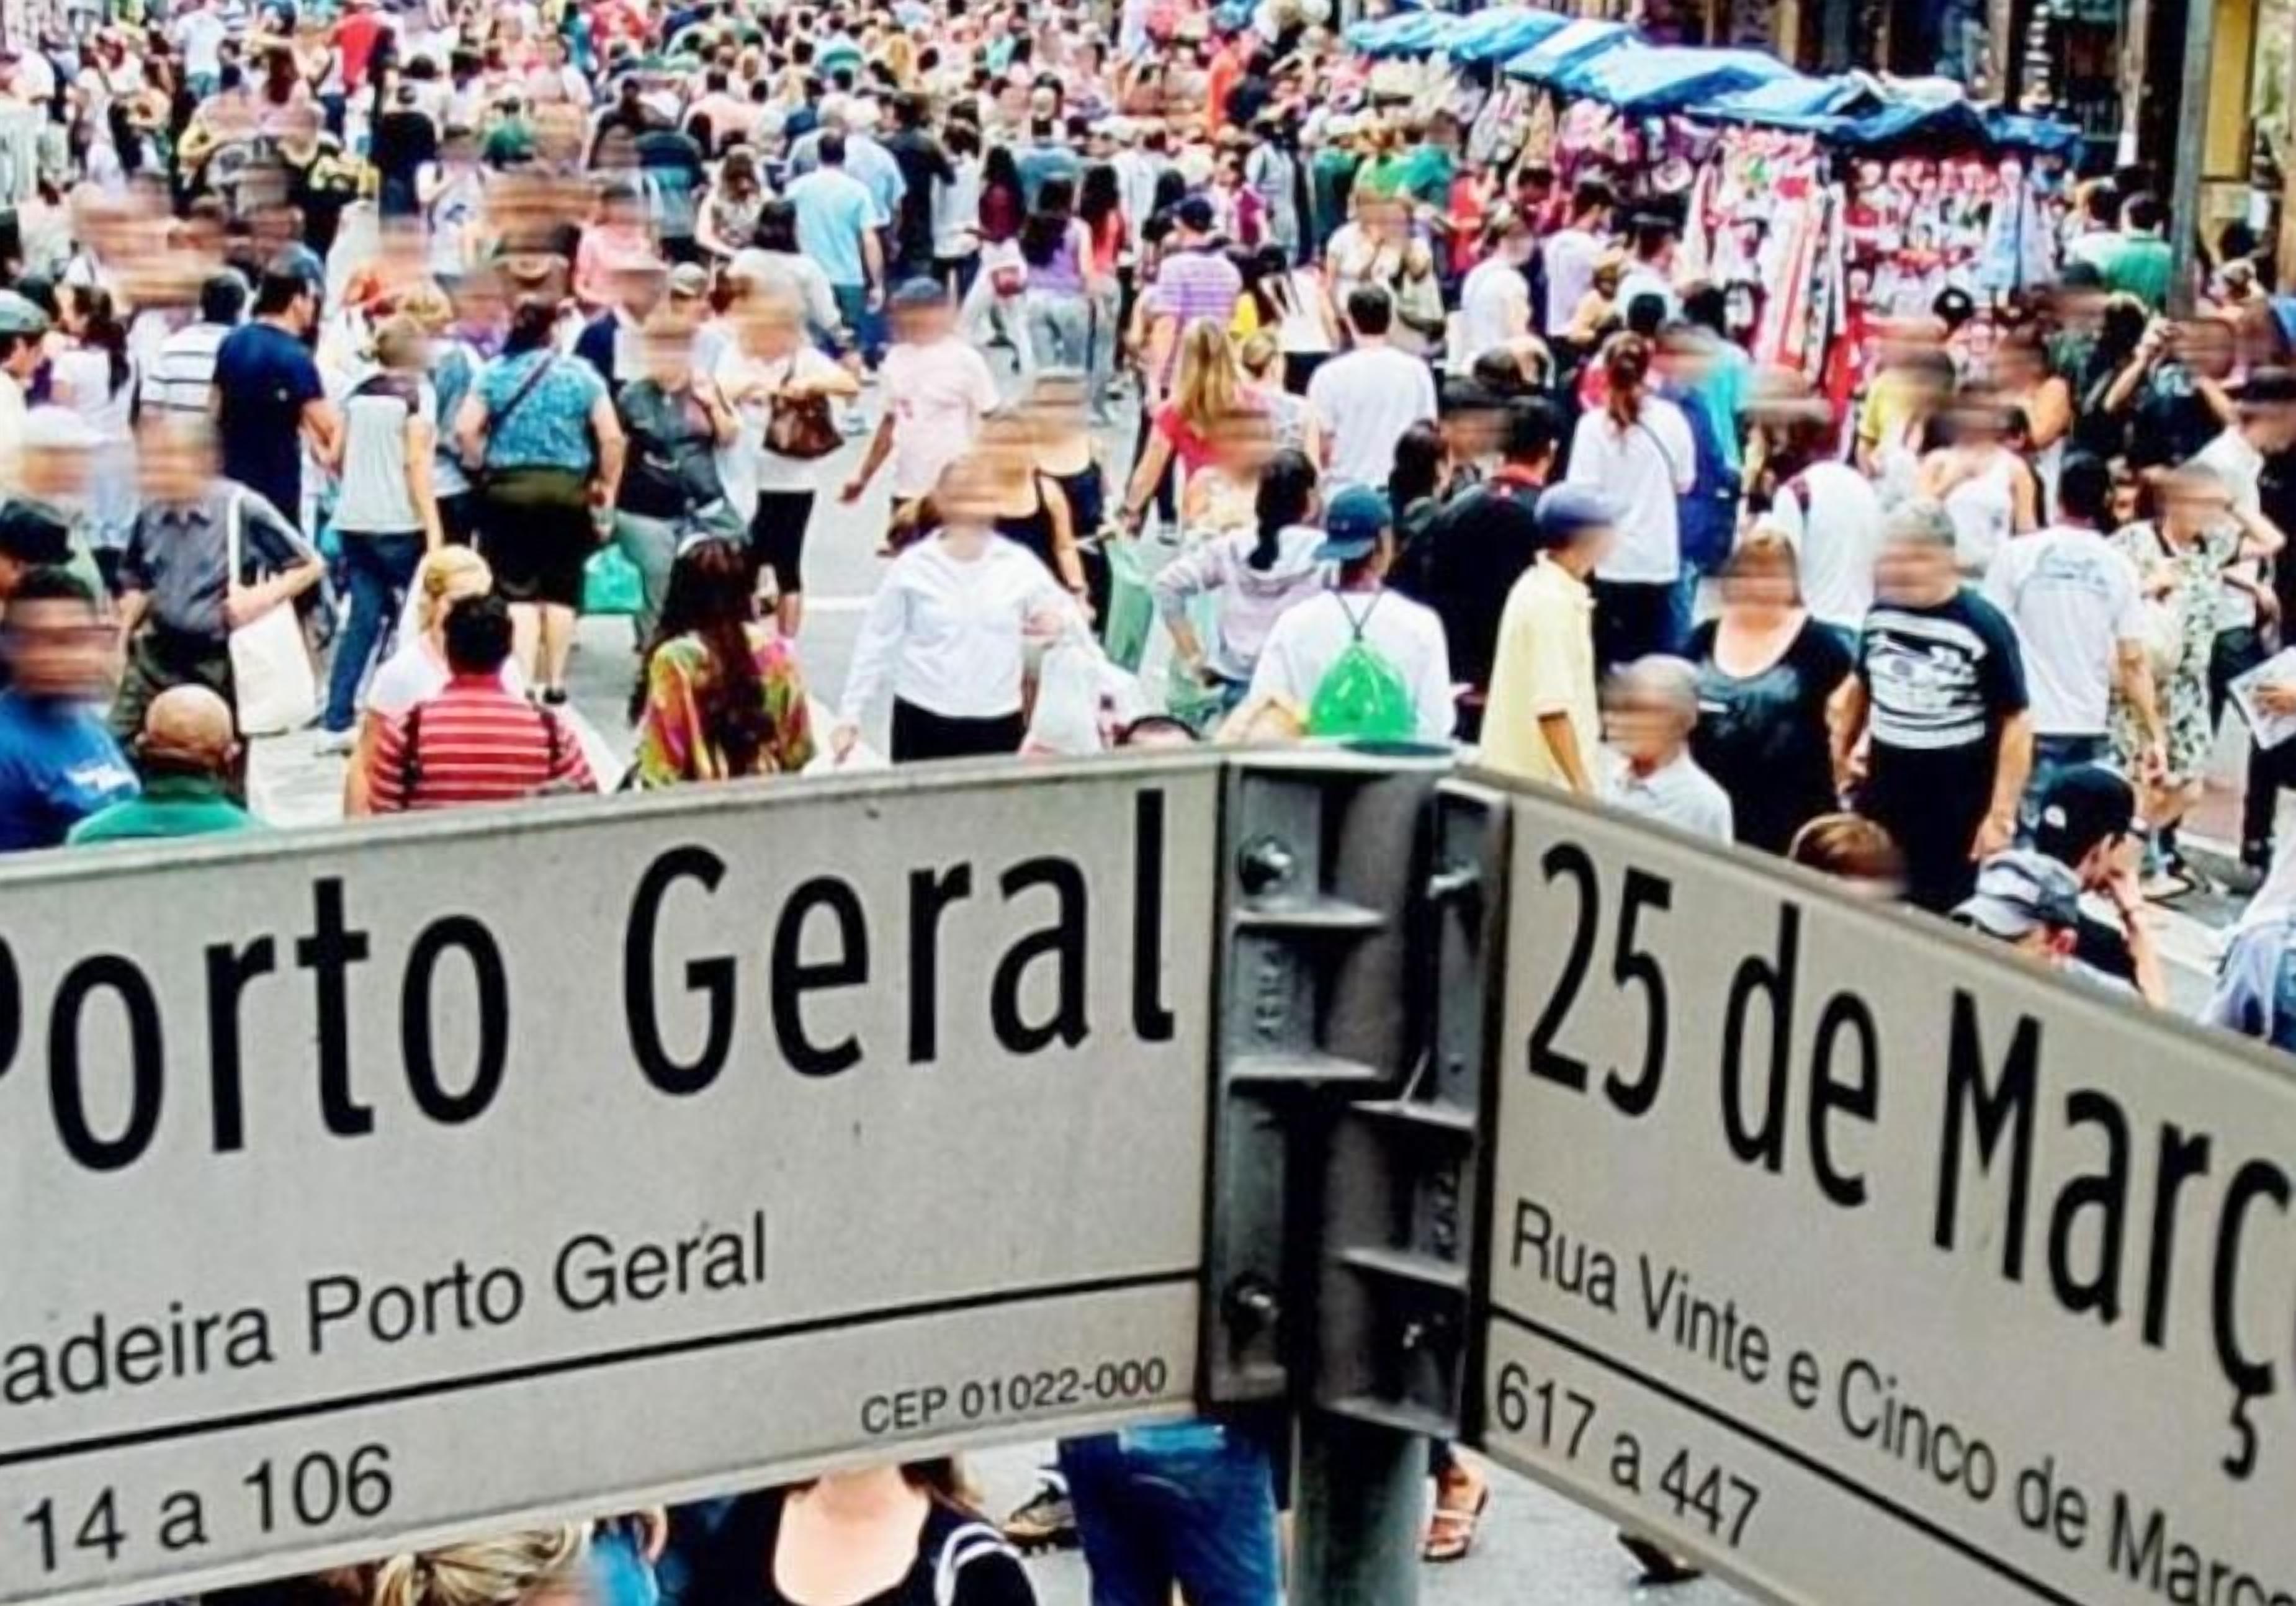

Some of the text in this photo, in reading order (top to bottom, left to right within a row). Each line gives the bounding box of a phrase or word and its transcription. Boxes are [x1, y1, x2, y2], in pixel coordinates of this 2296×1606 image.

[0, 788, 1175, 1173] orto Geral
[1526, 840, 2296, 1482] 25 de Març
[2, 1209, 765, 1406] adeira Porto Geral
[861, 1357, 1168, 1435] CEP 01022-000
[1510, 1196, 1617, 1313] Rua
[1638, 1254, 1770, 1384] Vinte
[1787, 1350, 1820, 1411] e
[1837, 1358, 1997, 1503] Cinco
[2015, 1456, 2088, 1551] de
[2107, 1491, 2296, 1606] Mar
[24, 1443, 393, 1572] 14 a 106
[1496, 1361, 1760, 1549] 617 a 447
